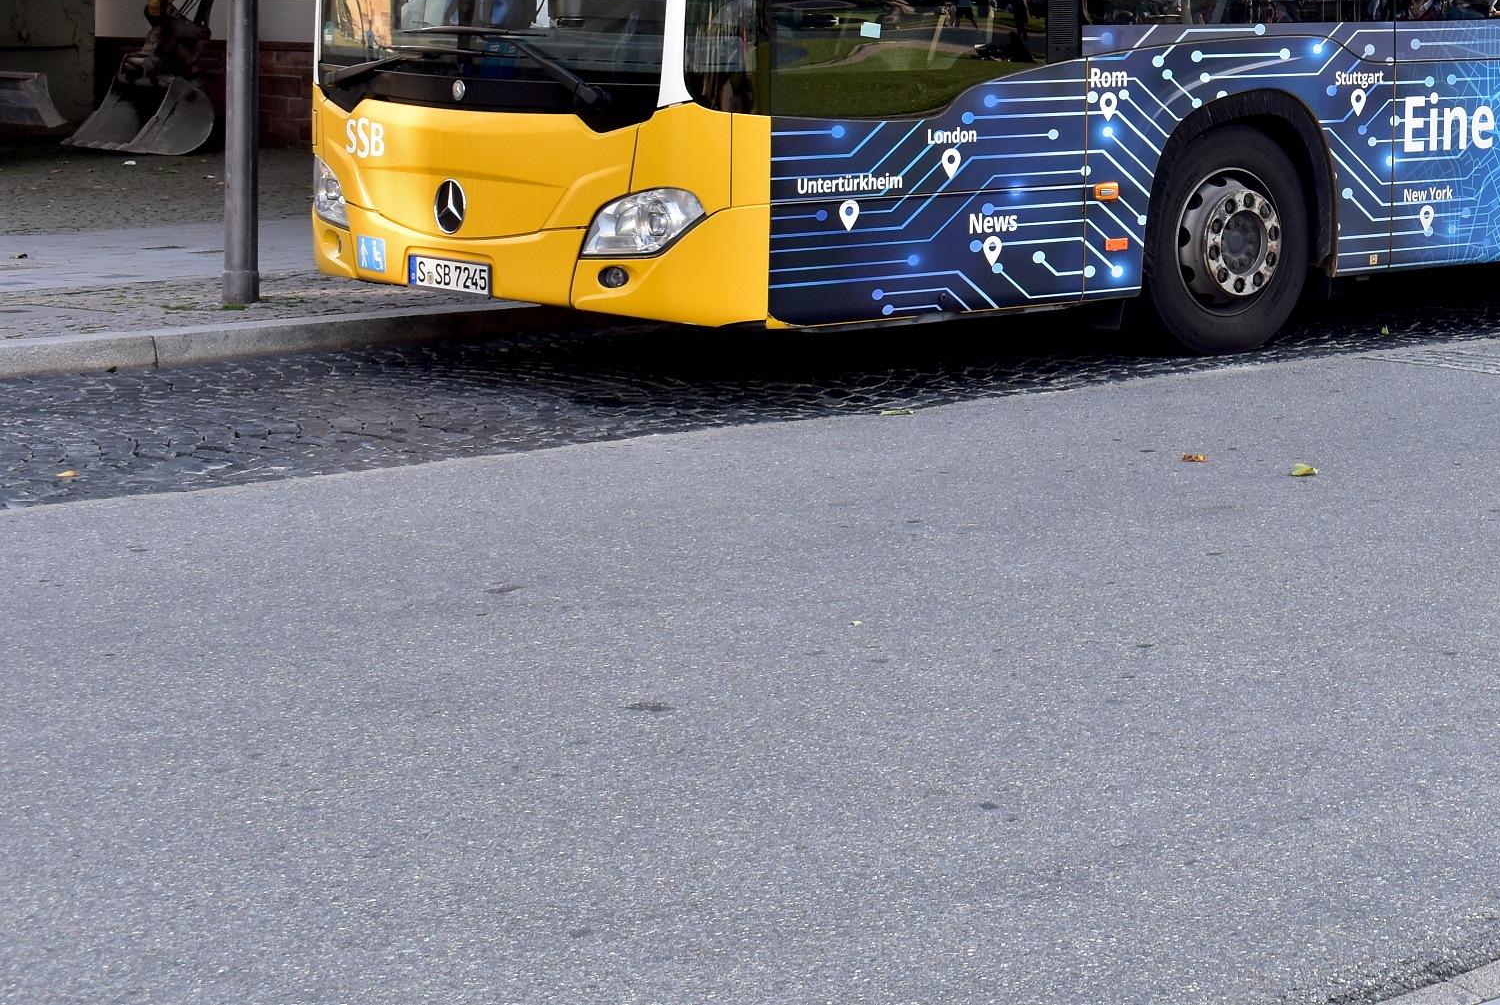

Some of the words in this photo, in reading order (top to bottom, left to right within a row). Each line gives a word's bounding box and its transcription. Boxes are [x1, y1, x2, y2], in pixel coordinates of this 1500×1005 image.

[1090, 68, 1127, 88] Rom
[1335, 70, 1384, 88] Stuttgart
[1403, 92, 1495, 153] Eine
[344, 117, 385, 159] SSB
[927, 128, 977, 145] London
[797, 173, 903, 194] Untertürkheim
[1403, 188, 1426, 202] New
[1429, 186, 1453, 201] York
[969, 212, 1018, 235] News
[418, 261, 426, 283] S
[435, 263, 451, 286] SB
[455, 265, 487, 290] 7245
